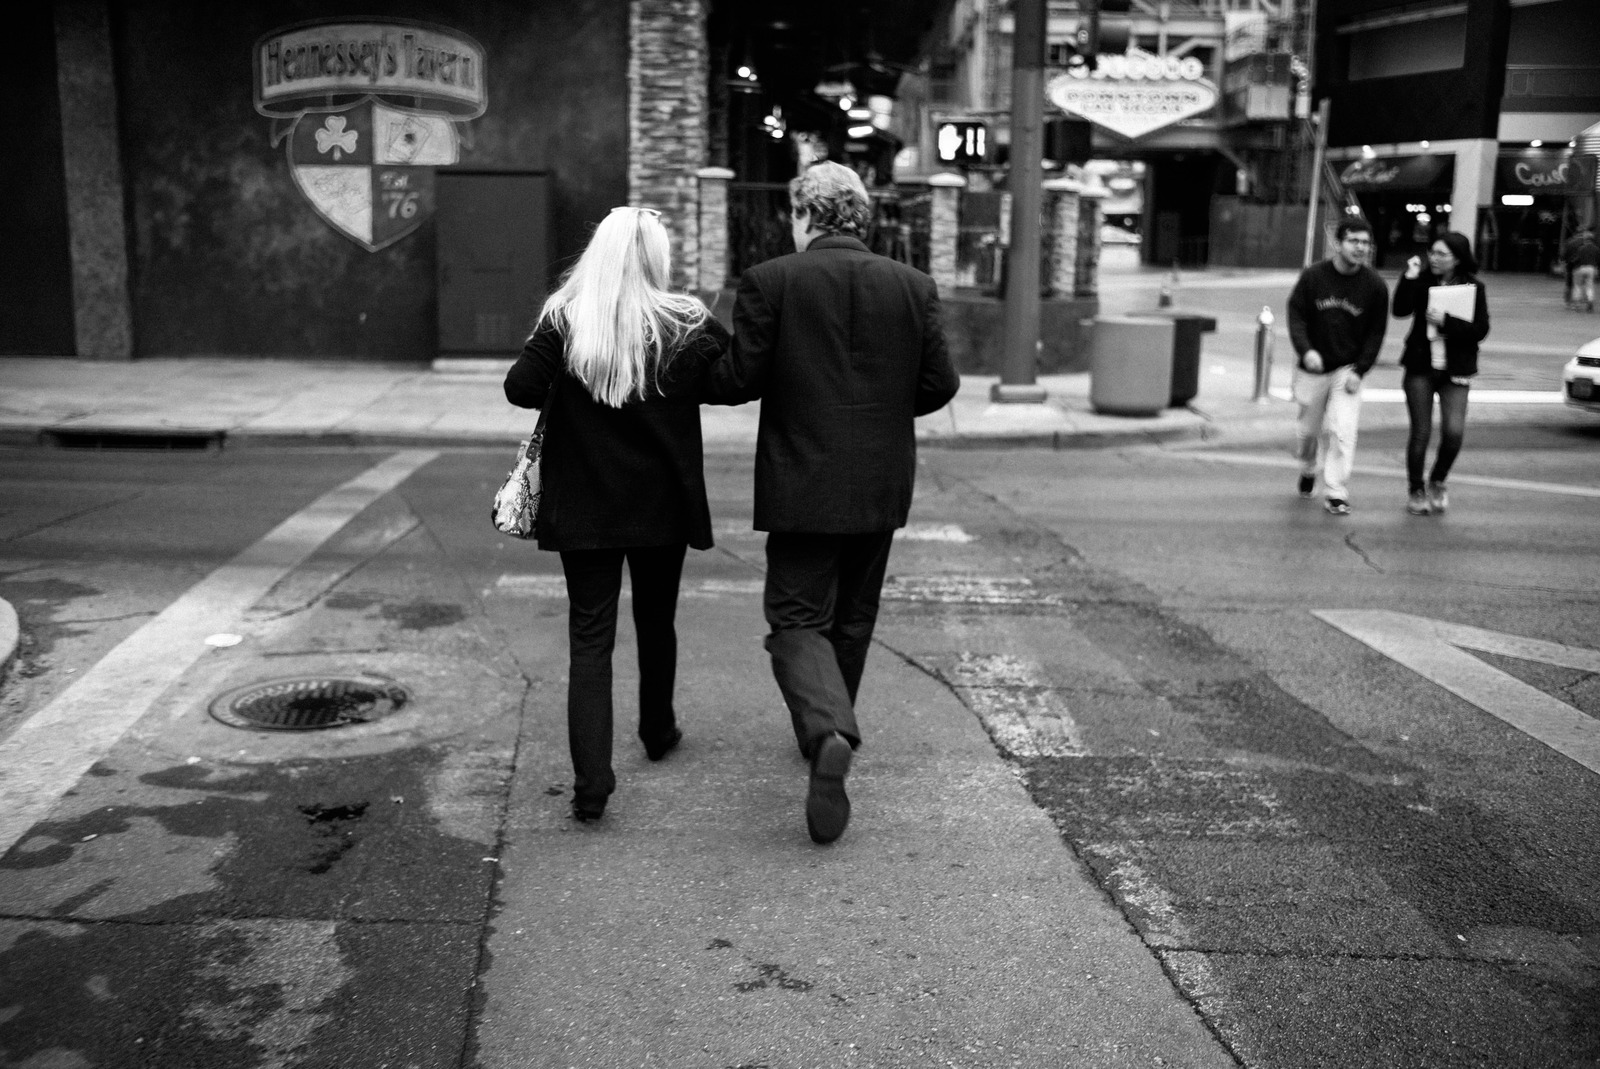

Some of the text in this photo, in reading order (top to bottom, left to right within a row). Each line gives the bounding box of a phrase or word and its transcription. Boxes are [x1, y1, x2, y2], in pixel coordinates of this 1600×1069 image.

[266, 33, 475, 90] Hennessey's Tavern
[1067, 90, 1200, 102] DOWNTOWN
[1082, 102, 1183, 114] LAS VEGAS
[966, 127, 986, 156] 11
